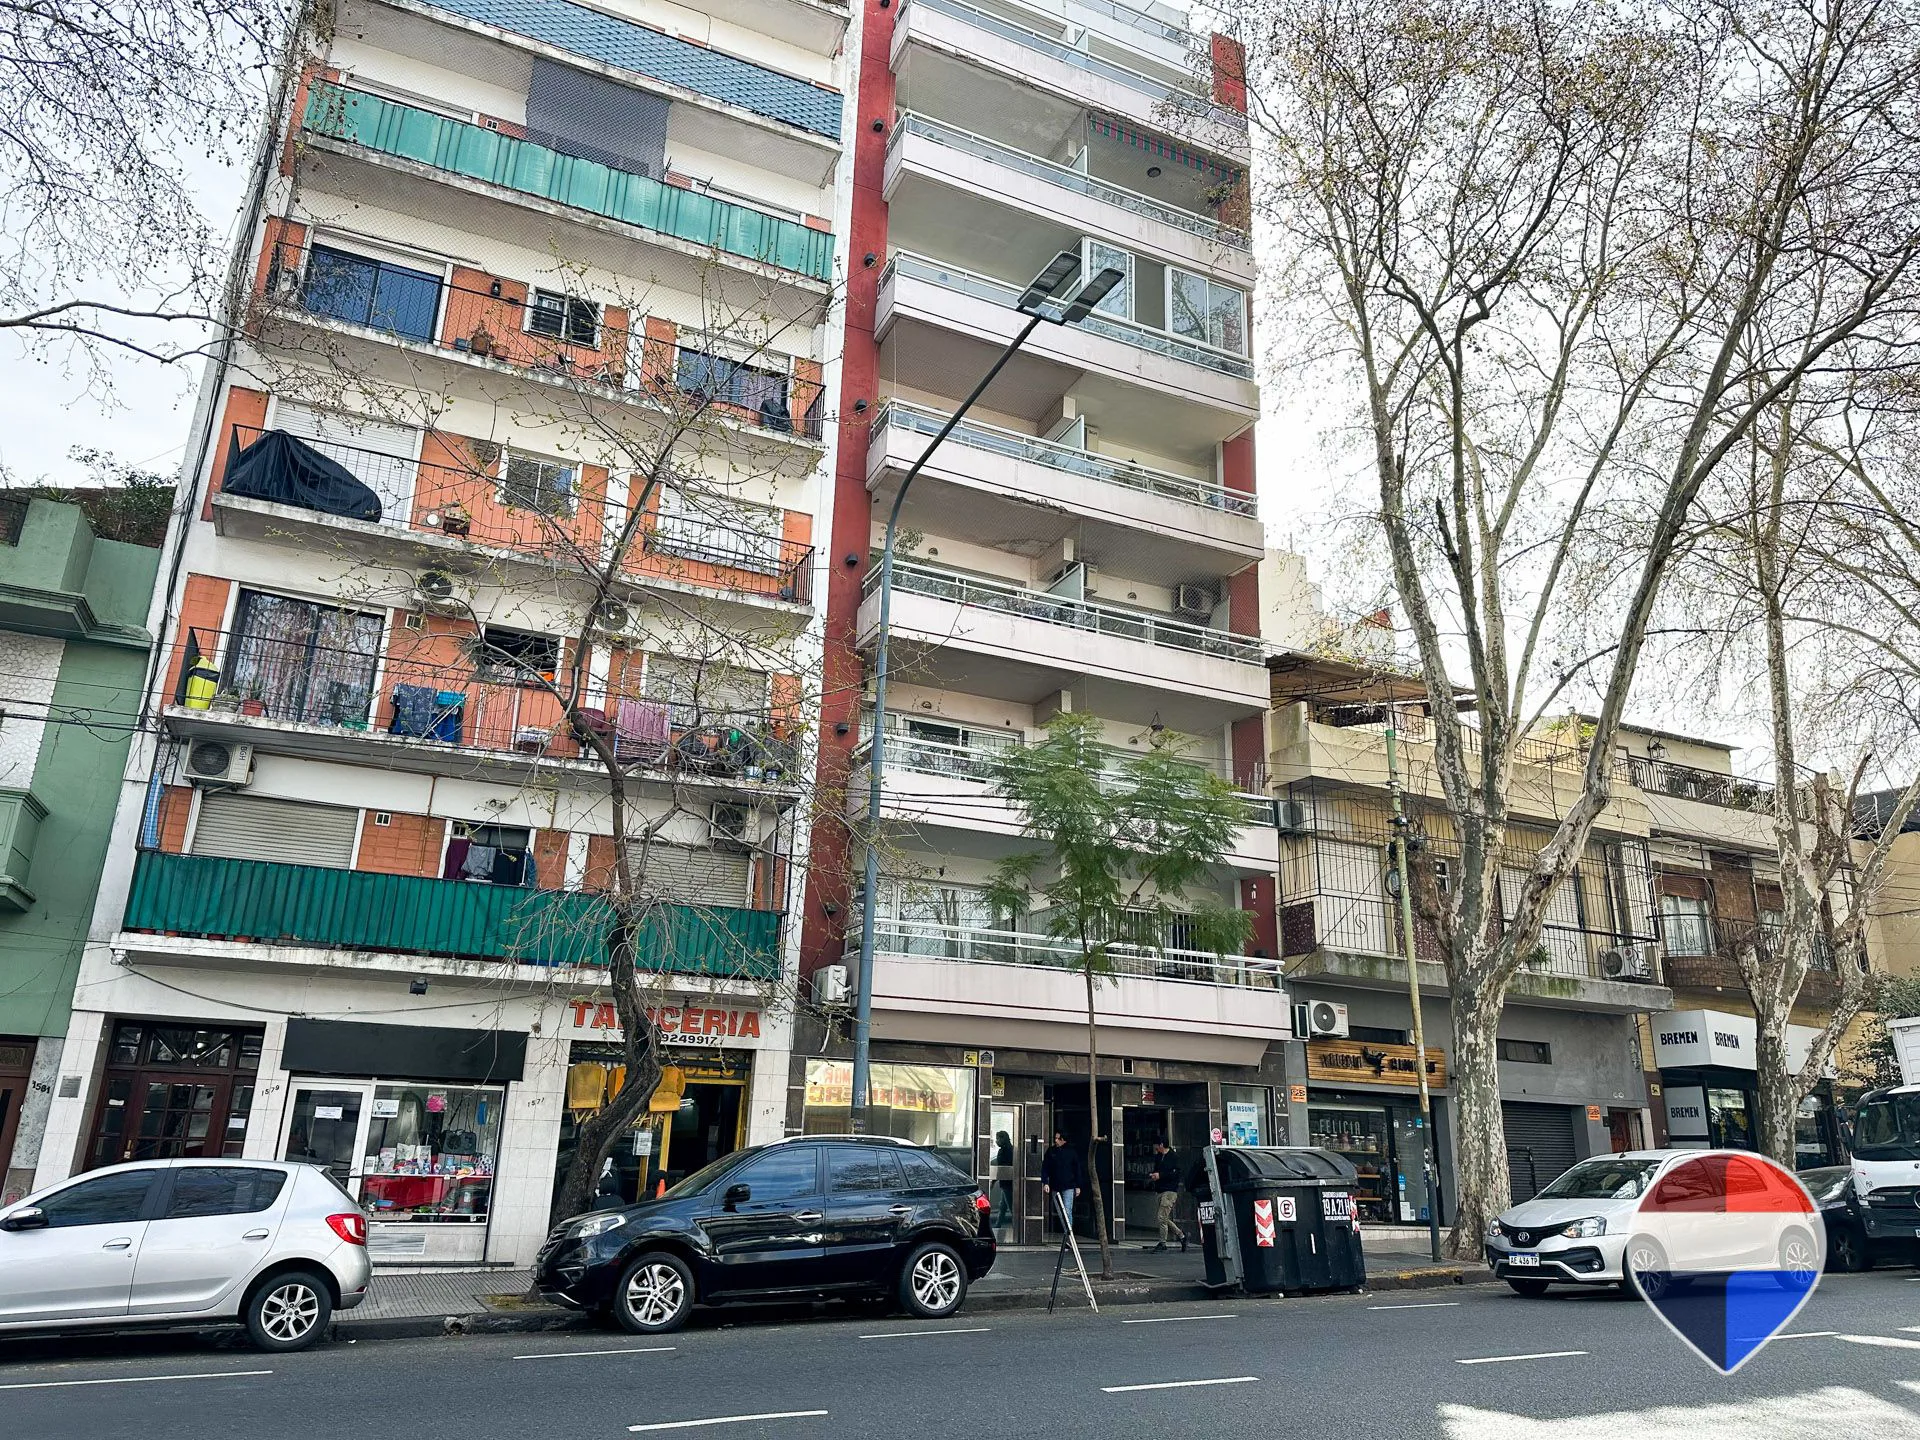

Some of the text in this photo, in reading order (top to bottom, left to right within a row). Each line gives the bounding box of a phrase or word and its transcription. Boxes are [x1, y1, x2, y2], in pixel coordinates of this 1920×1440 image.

[239, 746, 247, 760] BGH
[569, 1000, 760, 1038] TACERIA
[1660, 1031, 1699, 1046] BREMEN
[1715, 1031, 1740, 1049] BREMEN
[32, 1080, 50, 1094] 1581
[261, 1084, 280, 1096] 1579
[1229, 1105, 1256, 1113] SAMSUNG
[1670, 1106, 1700, 1119] BREMEN
[1510, 1256, 1518, 1265] AE
